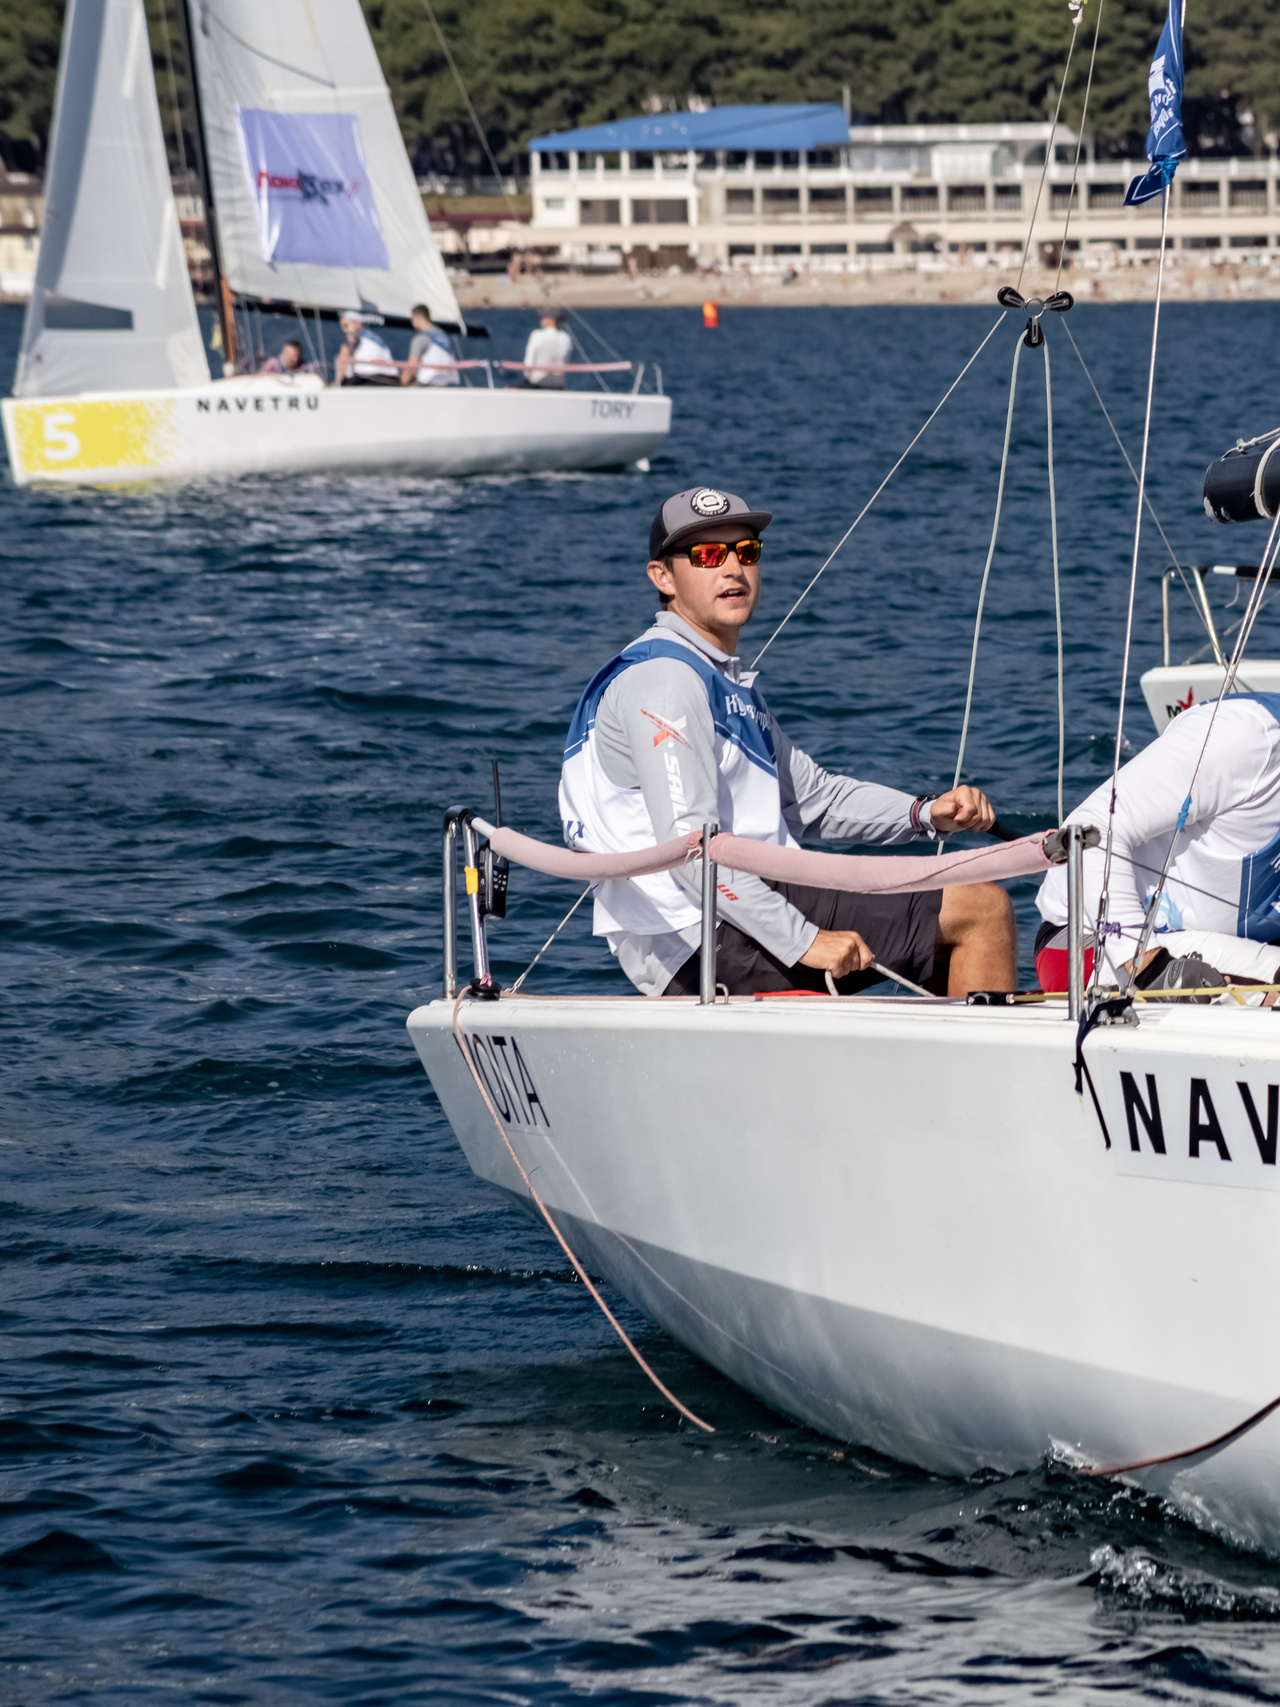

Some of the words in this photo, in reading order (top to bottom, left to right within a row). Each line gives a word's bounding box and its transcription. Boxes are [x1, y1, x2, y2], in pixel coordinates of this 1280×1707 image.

[198, 395, 320, 413] NAVETRU
[590, 399, 636, 420] TORY
[44, 413, 82, 462] 5
